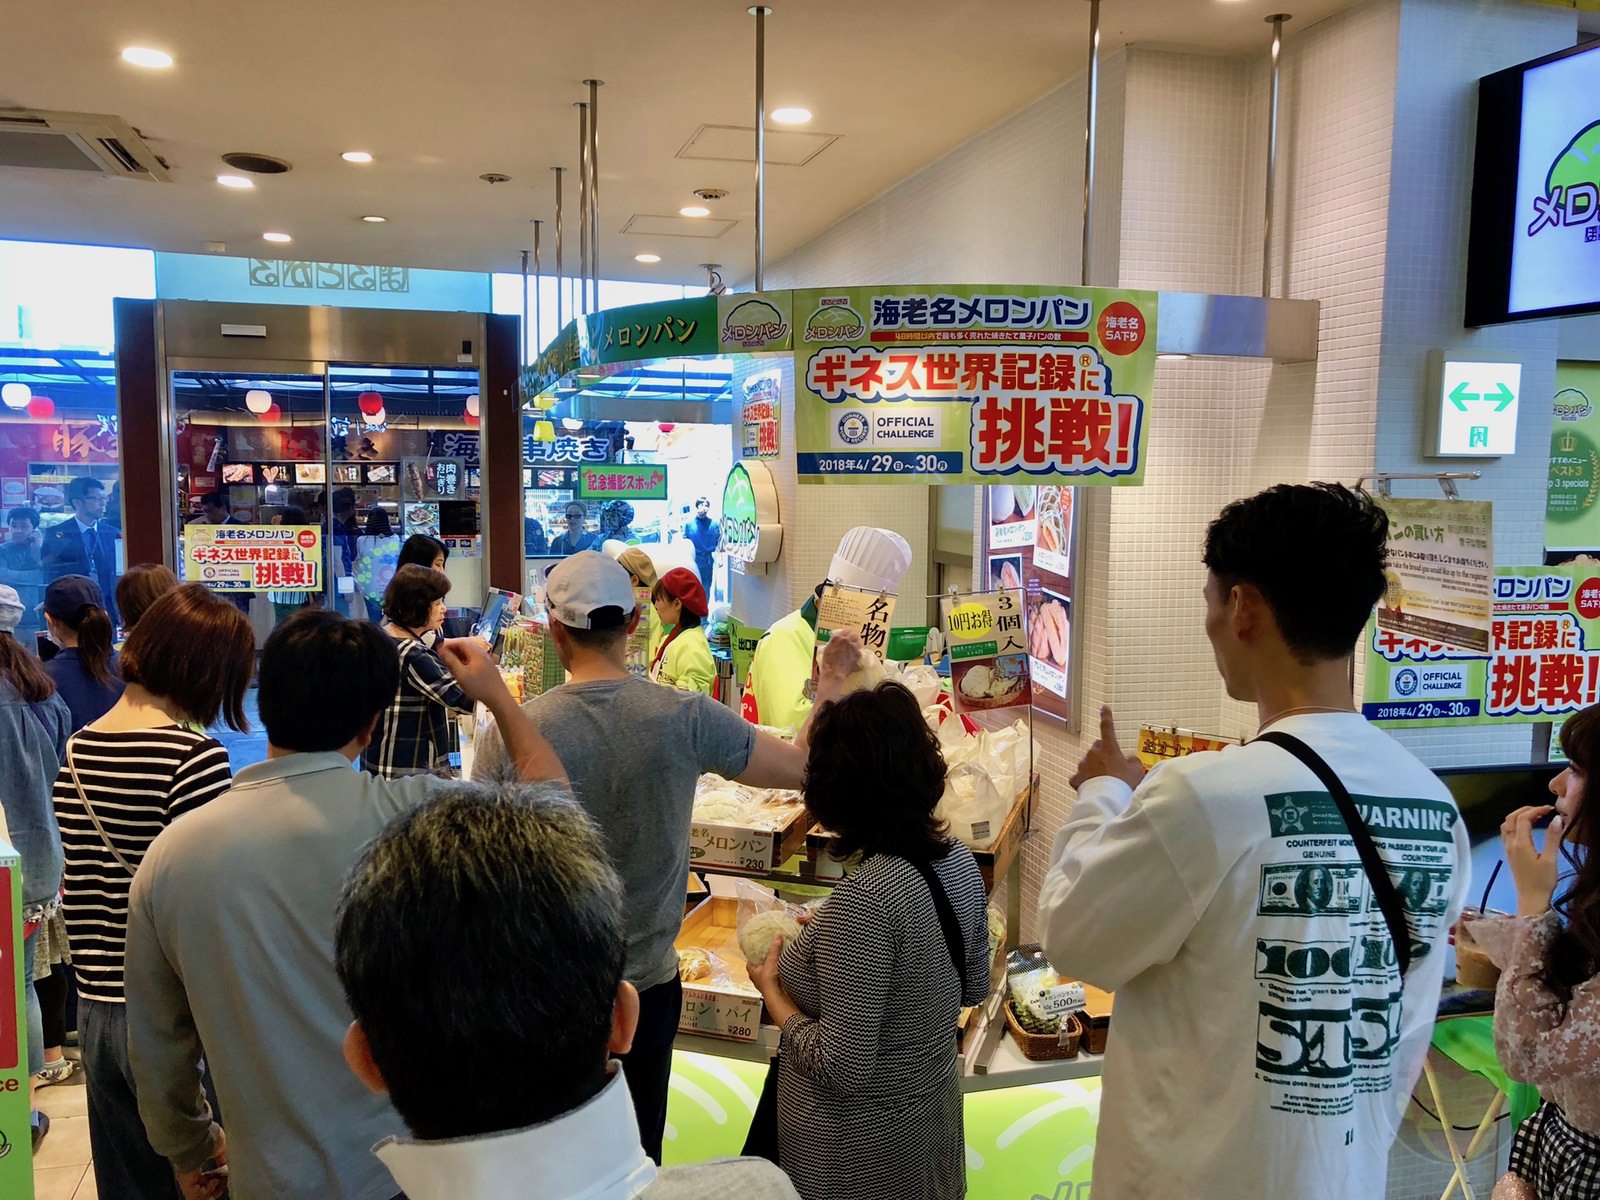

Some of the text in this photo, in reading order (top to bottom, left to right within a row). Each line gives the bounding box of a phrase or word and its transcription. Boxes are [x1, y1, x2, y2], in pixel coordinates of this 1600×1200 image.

[1527, 181, 1600, 238] メロ
[873, 297, 1089, 327] 海老名メロンパン
[1105, 316, 1139, 329] 海老名
[603, 315, 698, 351] メロンパン
[722, 321, 787, 342] メロンパン
[805, 321, 865, 341] メロンパン
[1105, 330, 1139, 342] SA下り
[877, 417, 935, 428] OFFICIAL
[876, 429, 935, 440] CHALLENGE
[1551, 465, 1584, 476] ベスト3
[436, 462, 446, 495] おにぎり
[446, 462, 457, 494] 肉巻き
[587, 472, 657, 491] 記念撮影スポット
[1555, 479, 1560, 487] 3
[216, 529, 294, 539] 海老名メロンパン
[1493, 577, 1571, 598] ロンパン
[1581, 589, 1600, 599] 海老
[948, 609, 993, 632] 10円お得
[1422, 672, 1462, 681] OFFICIAL
[1422, 681, 1462, 691] CHALLENGE
[703, 836, 767, 854] メロンパン
[1286, 839, 1338, 848] COUNTERFEIT
[1302, 850, 1336, 859] GENUINE
